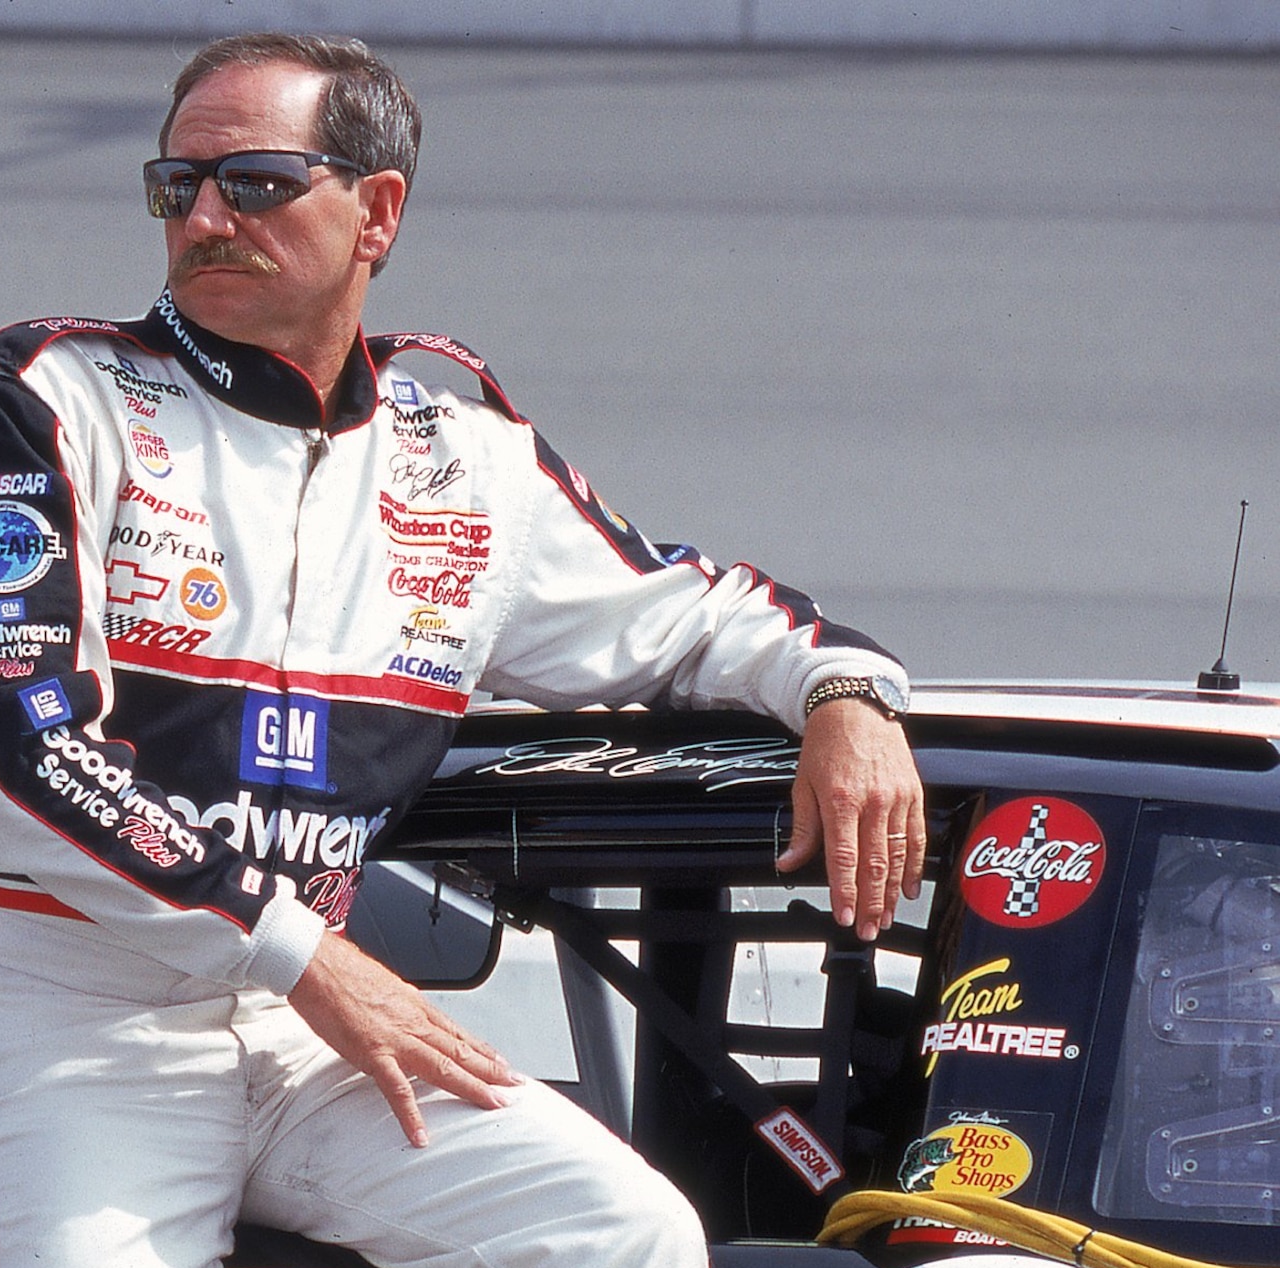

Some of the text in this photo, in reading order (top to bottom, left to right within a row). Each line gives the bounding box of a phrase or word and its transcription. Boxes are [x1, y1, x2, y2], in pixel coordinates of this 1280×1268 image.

[94, 361, 188, 399] oodwrench
[125, 395, 157, 418] Plus
[131, 430, 166, 447] BURGER
[134, 442, 170, 461] KING
[397, 439, 431, 455] Plus
[450, 519, 492, 545] Cup
[109, 526, 225, 568] OODYEAR
[426, 555, 490, 572] CHAMPION
[186, 582, 220, 609] 76
[388, 567, 476, 609] Coca-Cola
[1, 602, 20, 617] GM
[123, 617, 212, 653] RCR
[400, 626, 467, 650] REALTREE
[37, 689, 64, 719] GM
[256, 705, 315, 766] GM
[41, 725, 206, 863] Goodwrench
[36, 753, 181, 868] Service Plus
[963, 839, 1101, 882] Coca-Cola
[942, 958, 1023, 1022] Team
[920, 1022, 1067, 1058] REALTREE
[772, 1119, 833, 1182] SIMPSON
[957, 1127, 1012, 1150] Bass
[956, 1148, 994, 1168] Pro
[951, 1166, 1017, 1192] Shops
